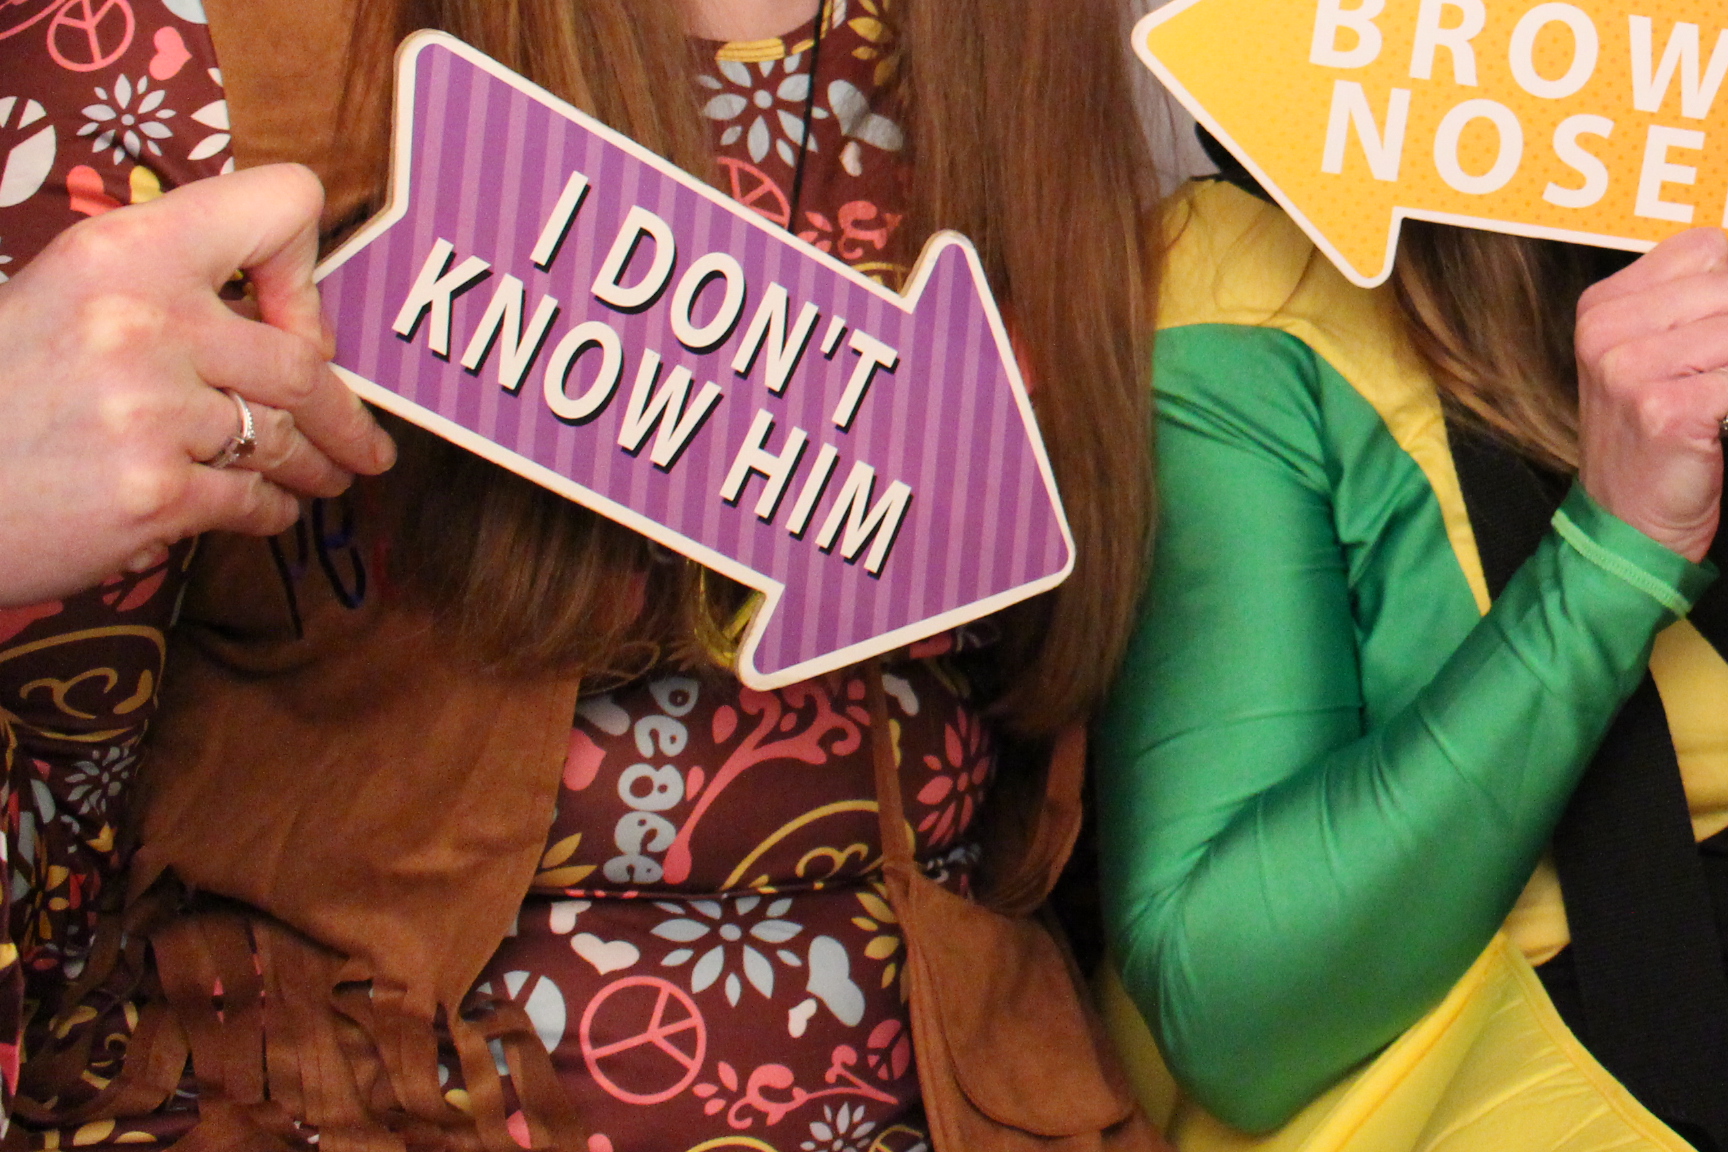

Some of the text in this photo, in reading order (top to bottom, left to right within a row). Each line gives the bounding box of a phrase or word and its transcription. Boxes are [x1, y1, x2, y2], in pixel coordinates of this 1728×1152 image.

[391, 237, 914, 575] KNOW HIM
[529, 170, 900, 430] I DON'T
